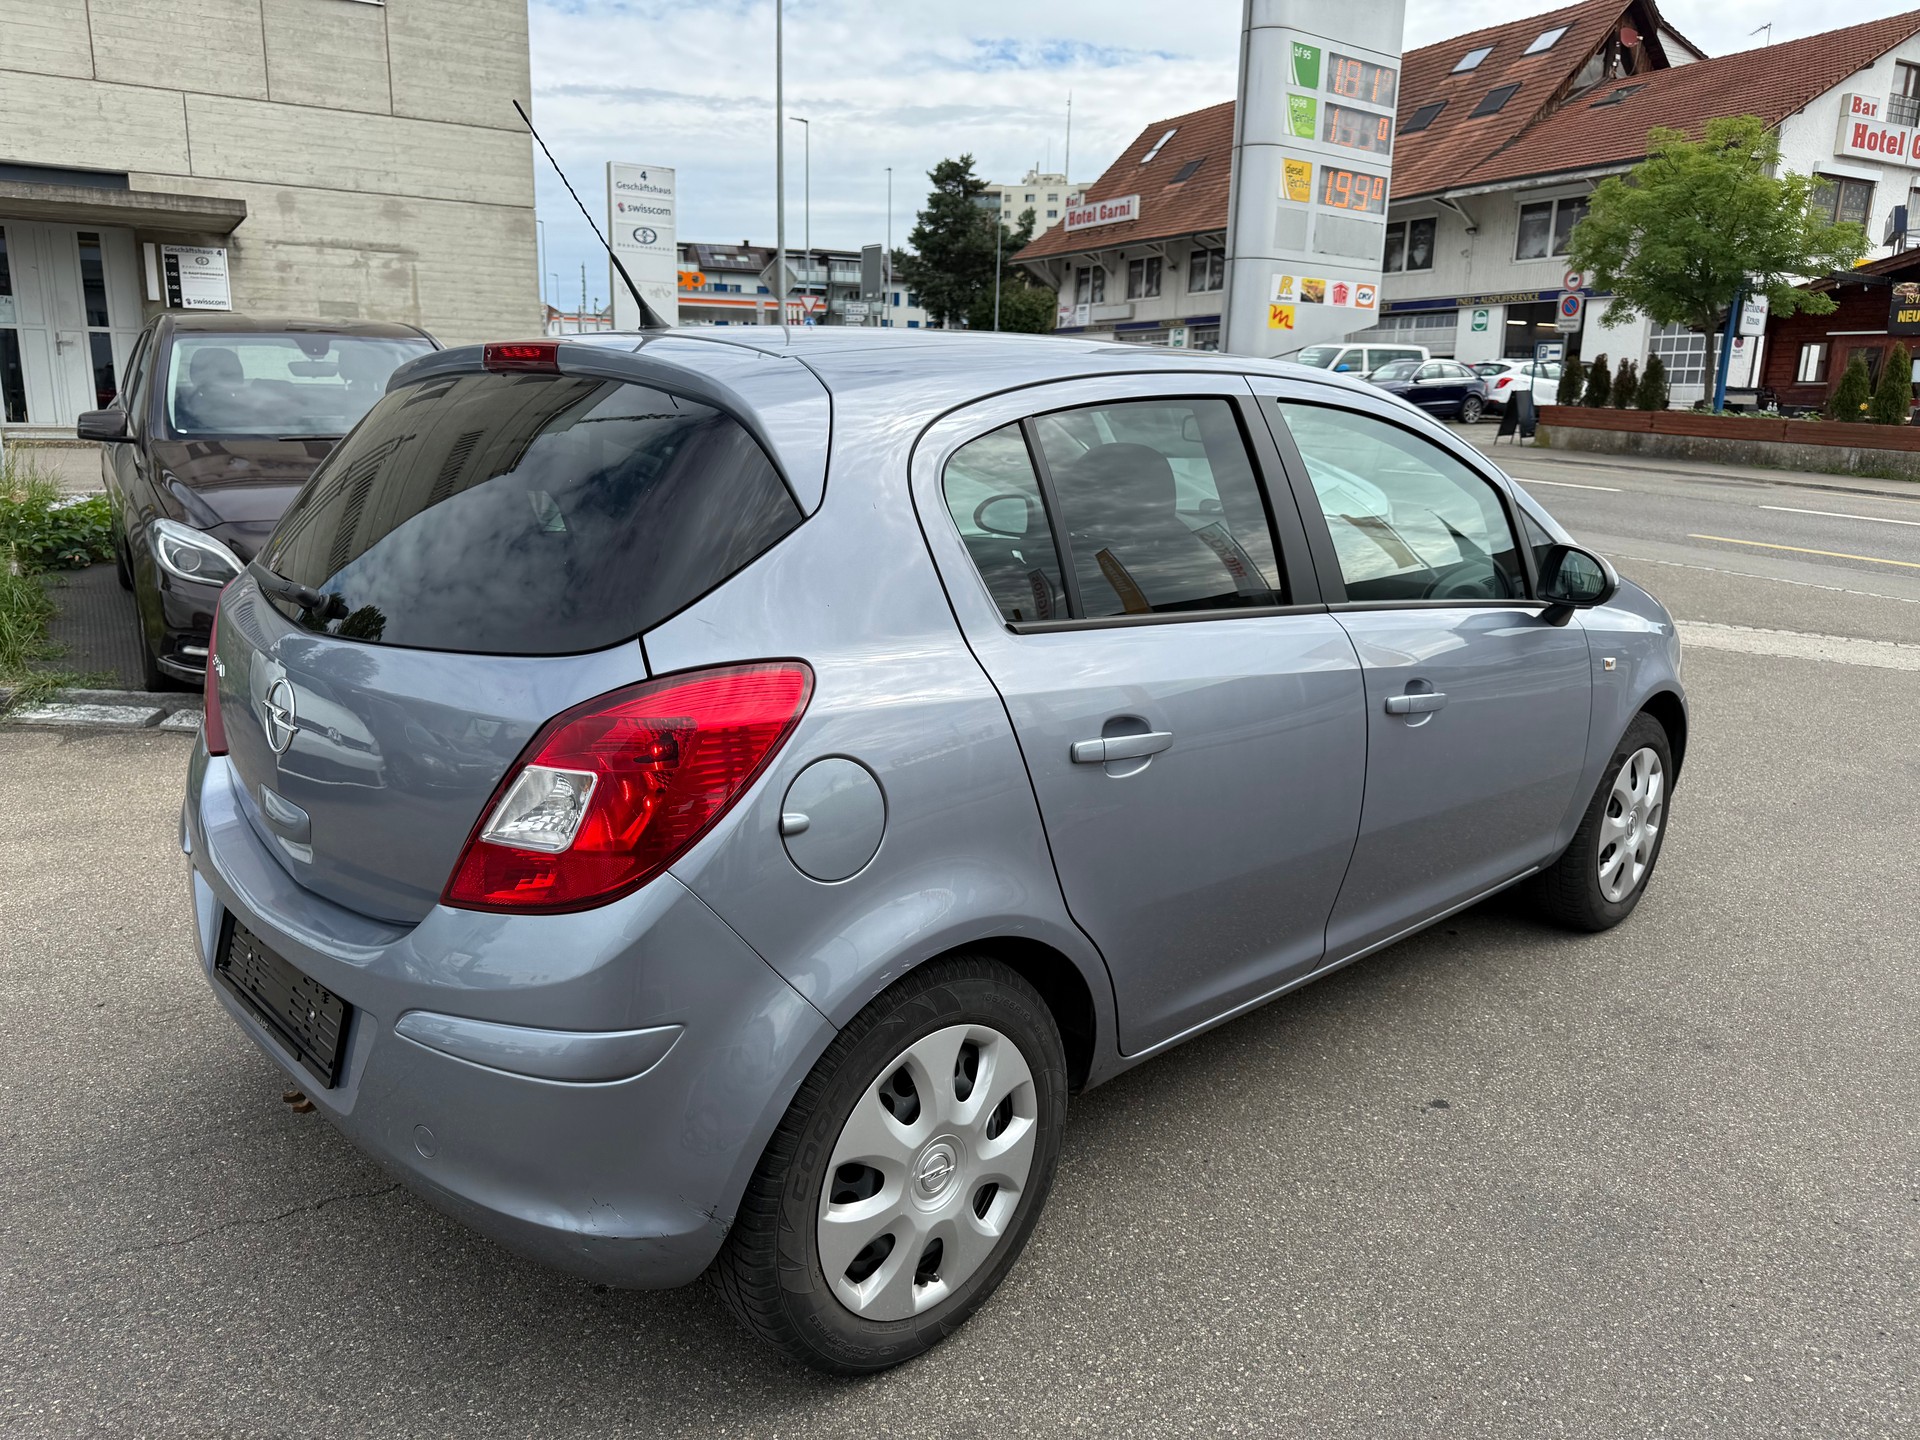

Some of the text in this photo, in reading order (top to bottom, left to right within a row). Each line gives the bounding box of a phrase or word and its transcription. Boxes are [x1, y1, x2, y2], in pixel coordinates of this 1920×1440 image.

[1852, 96, 1877, 116] Bar
[1852, 123, 1906, 156] Hotel
[640, 171, 647, 181] 4
[616, 181, 671, 194] Geschäftshaus
[628, 204, 671, 216] swisscom
[1069, 200, 1130, 226] Hotel Garni
[165, 246, 213, 255] Geschäftshaus
[193, 298, 227, 306] swisscom
